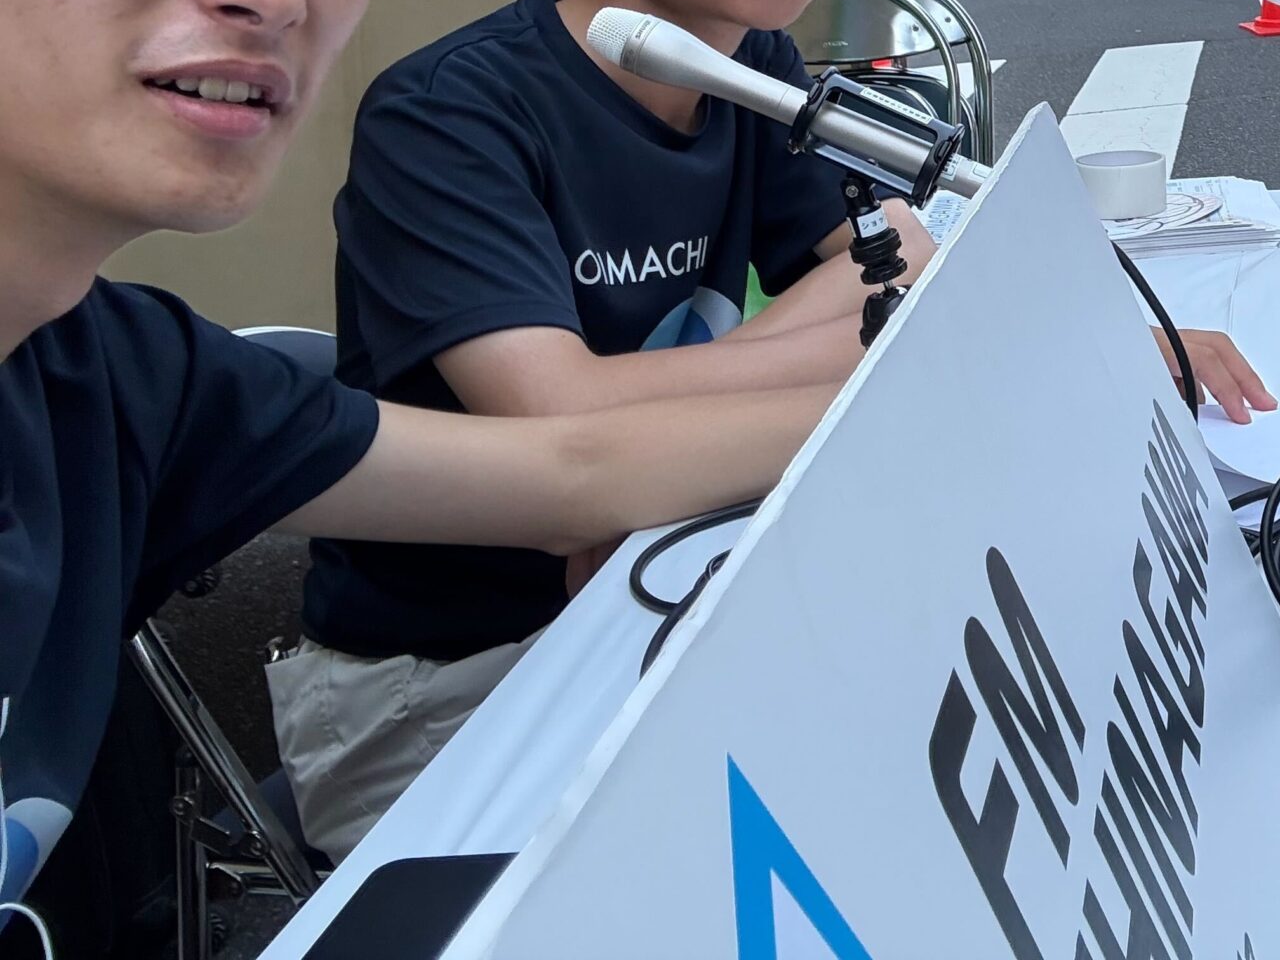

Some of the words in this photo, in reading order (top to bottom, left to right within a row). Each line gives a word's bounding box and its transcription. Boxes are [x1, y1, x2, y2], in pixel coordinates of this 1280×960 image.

[574, 236, 708, 286] OIMACHI
[929, 546, 1085, 960] FM
[1075, 399, 1209, 960] HINAGAWA
